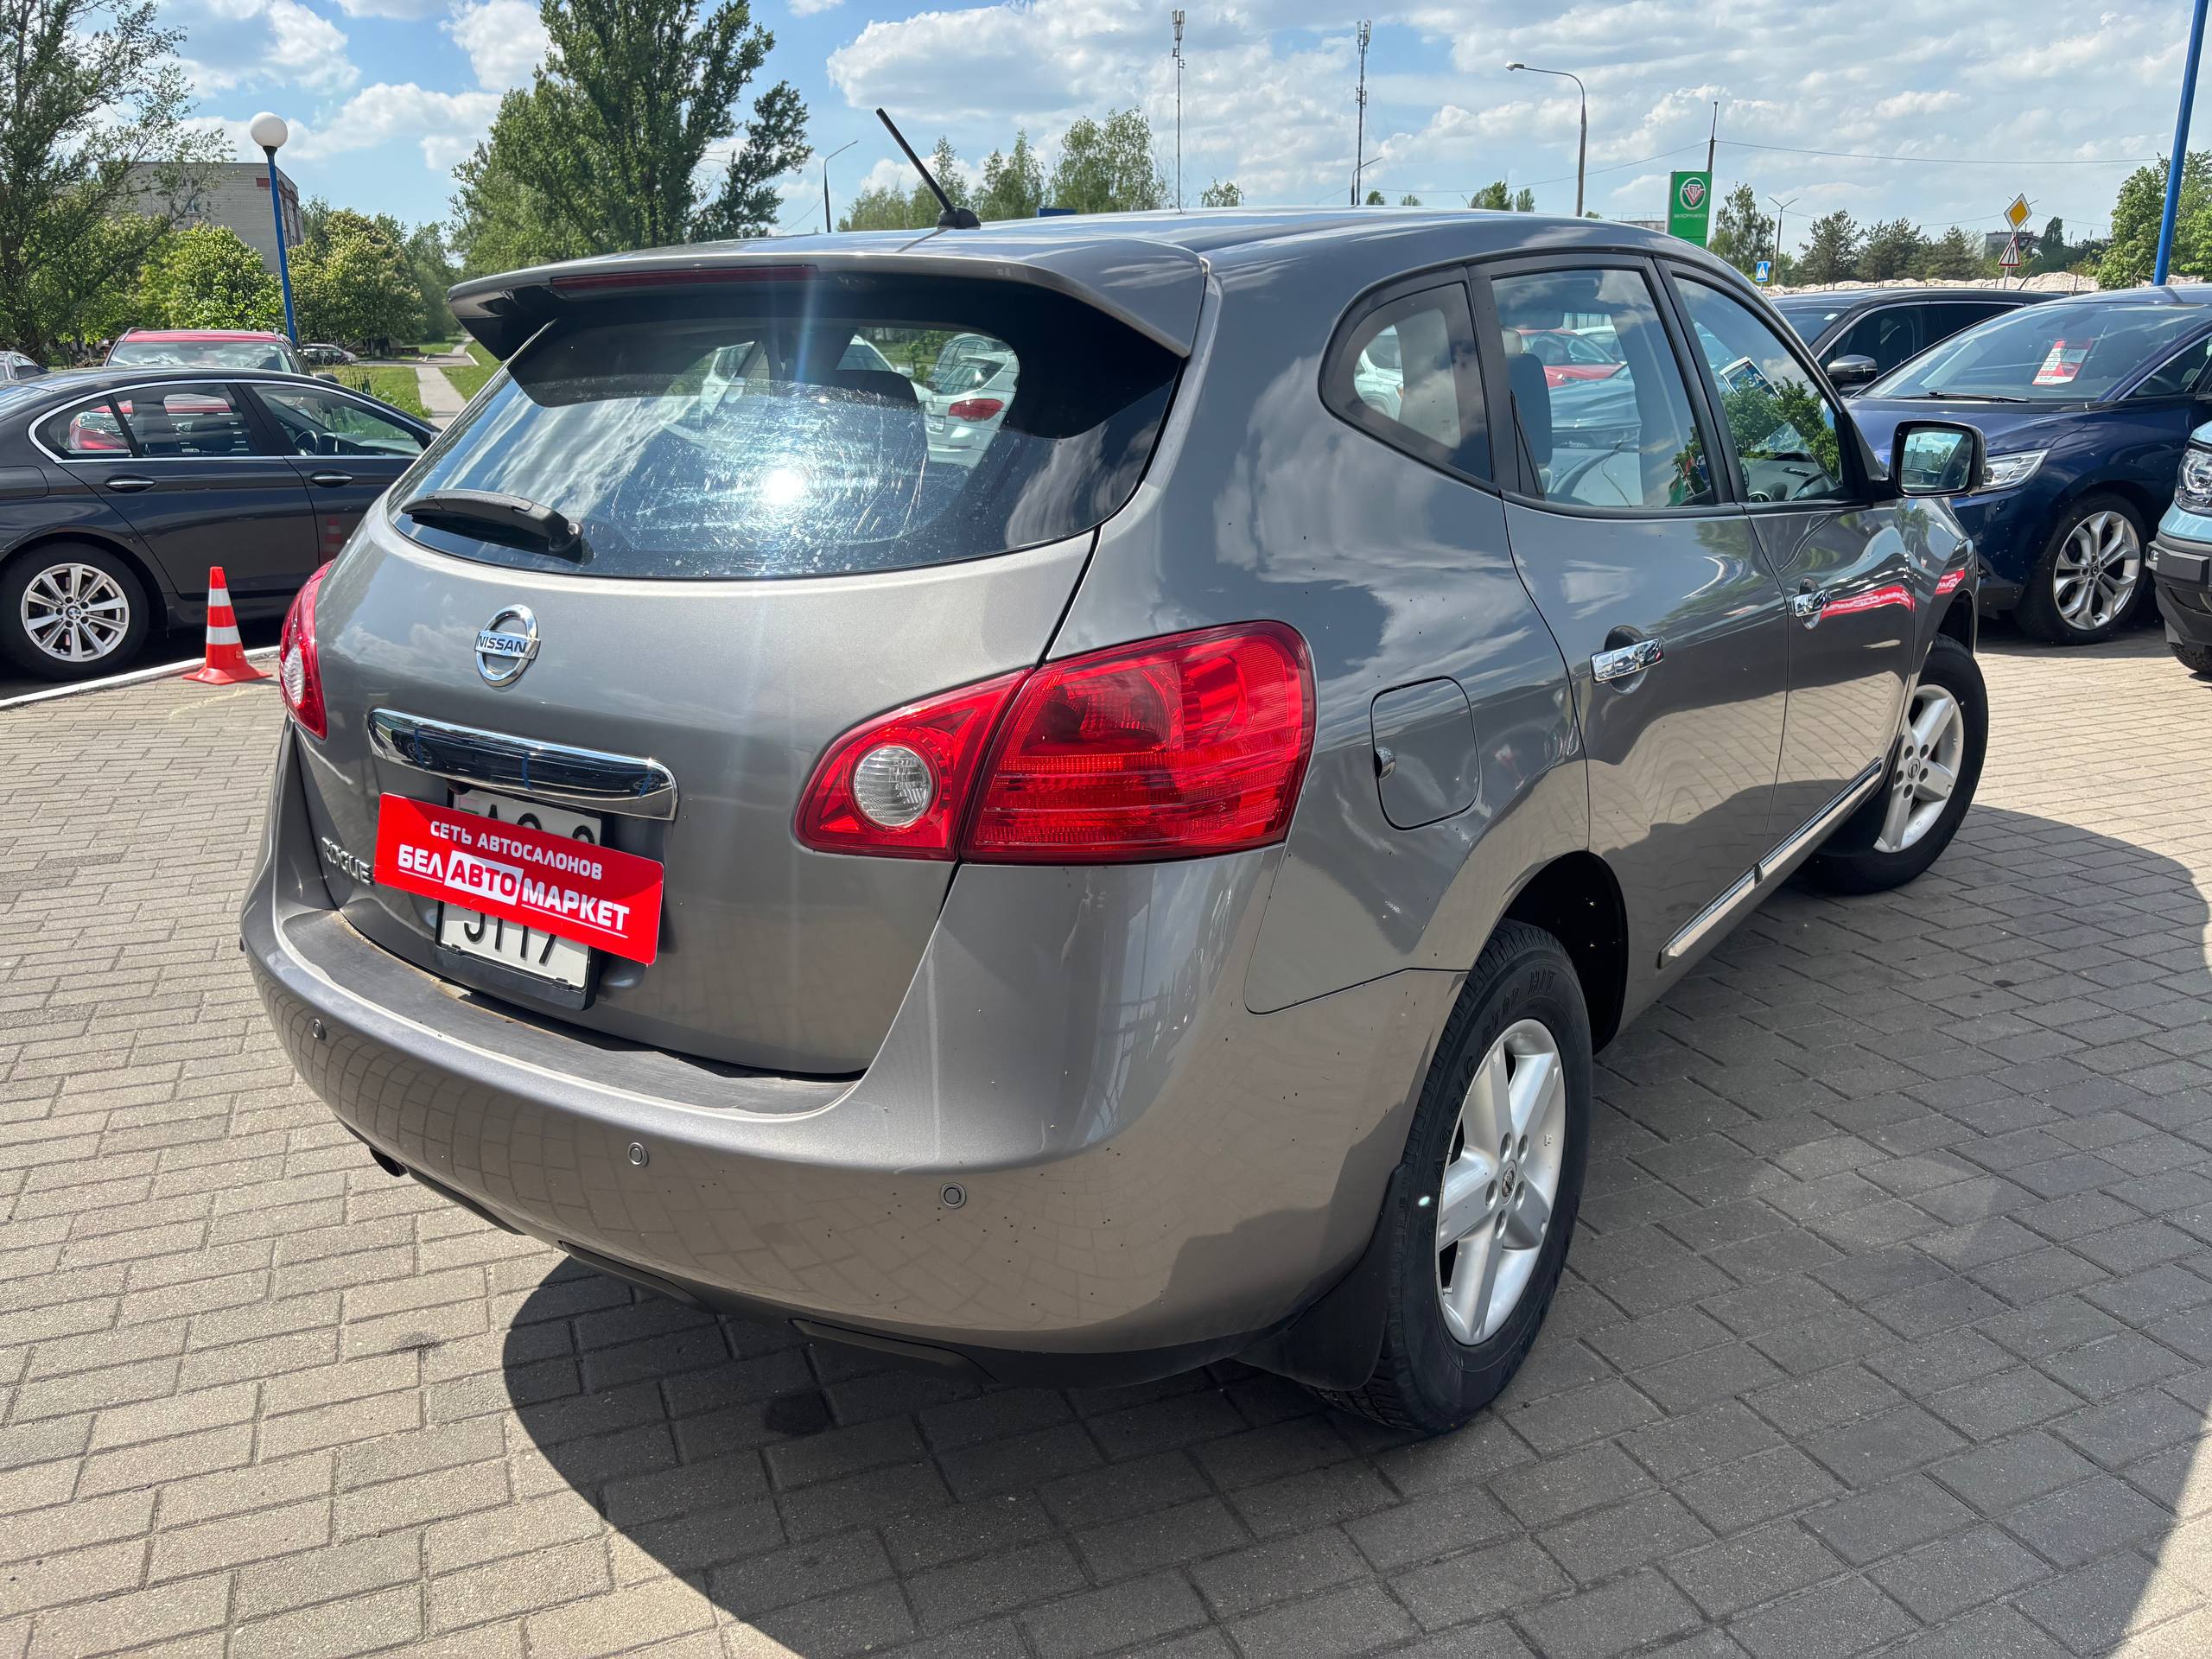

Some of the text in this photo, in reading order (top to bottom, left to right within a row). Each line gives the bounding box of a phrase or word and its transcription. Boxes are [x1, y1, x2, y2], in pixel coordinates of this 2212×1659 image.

[476, 635, 527, 653] NISSAN
[430, 820, 473, 846] СЕТЬ
[477, 832, 602, 881] АВТОСАЛОНОВ
